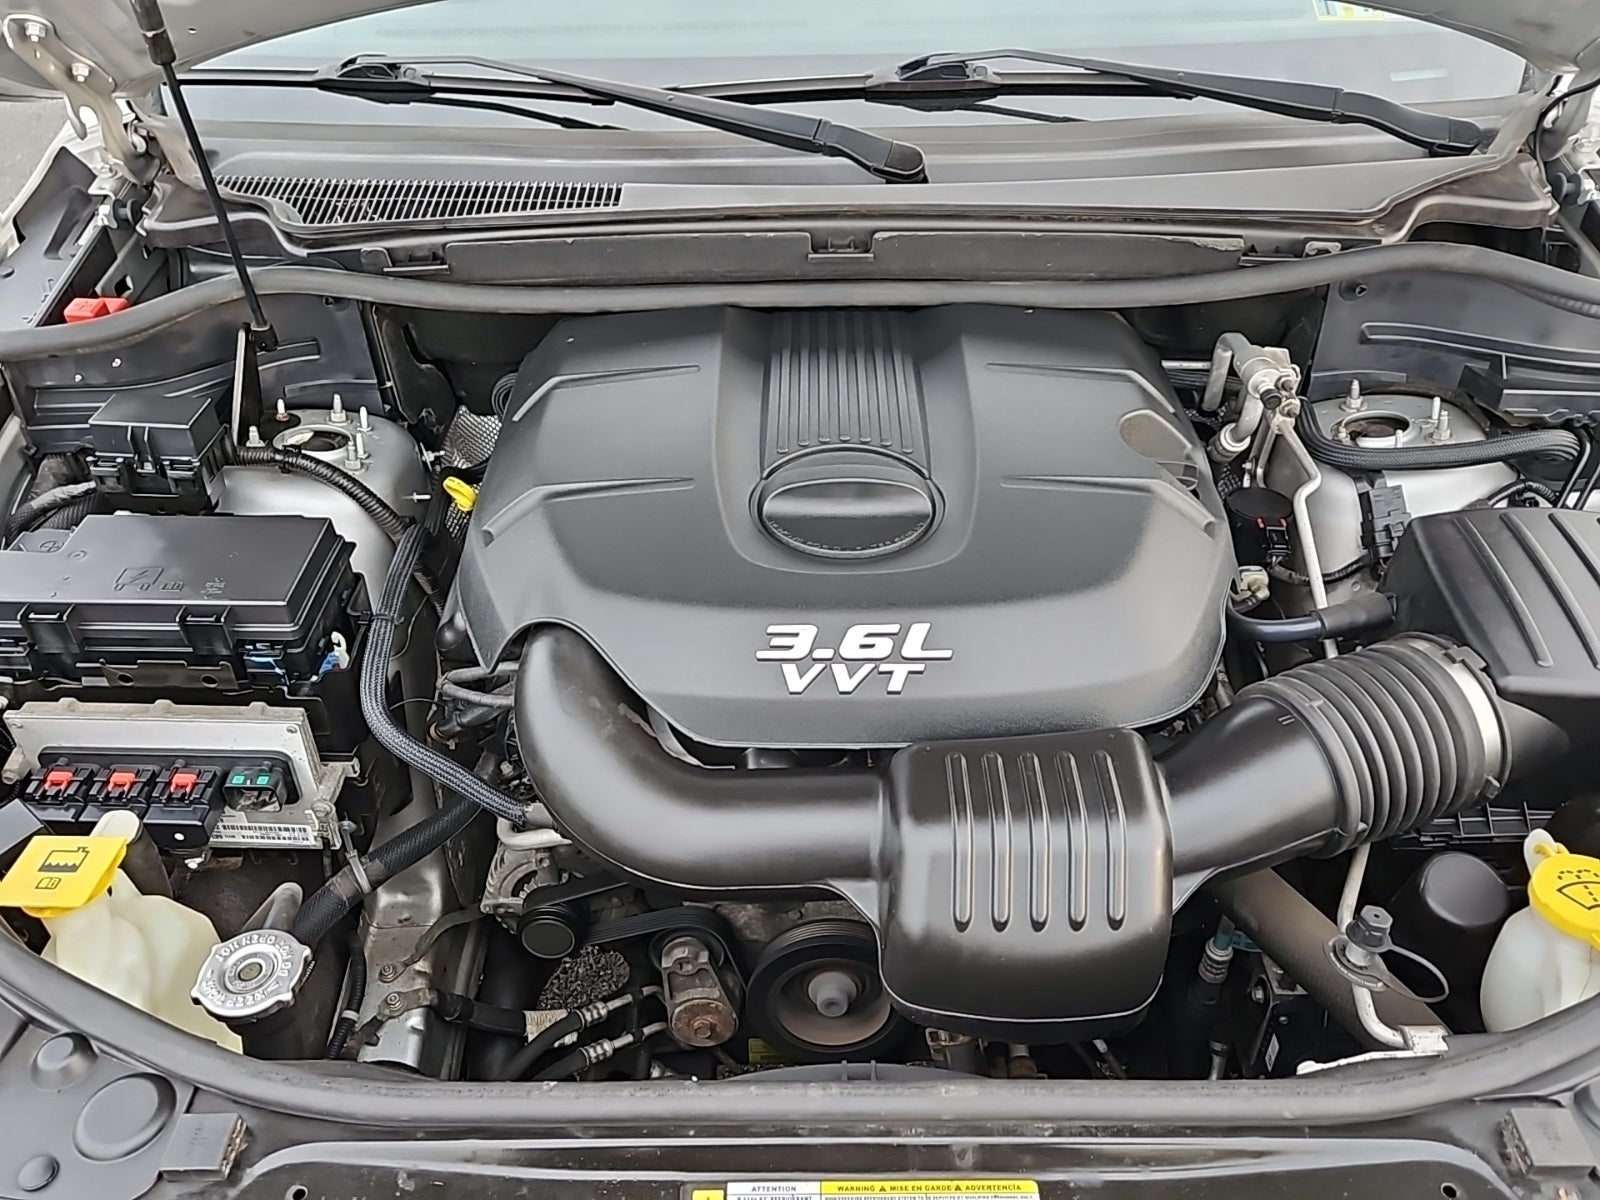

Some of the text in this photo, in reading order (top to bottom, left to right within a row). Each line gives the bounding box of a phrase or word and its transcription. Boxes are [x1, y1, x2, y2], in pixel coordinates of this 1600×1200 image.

[755, 622, 953, 661] 3.6L
[780, 663, 926, 695] VVT
[751, 1185, 797, 1193] ATTENTION
[837, 1184, 876, 1192] WARNING
[889, 1184, 909, 1192] MISE
[911, 1184, 922, 1192] EN
[924, 1184, 952, 1192] GARDE
